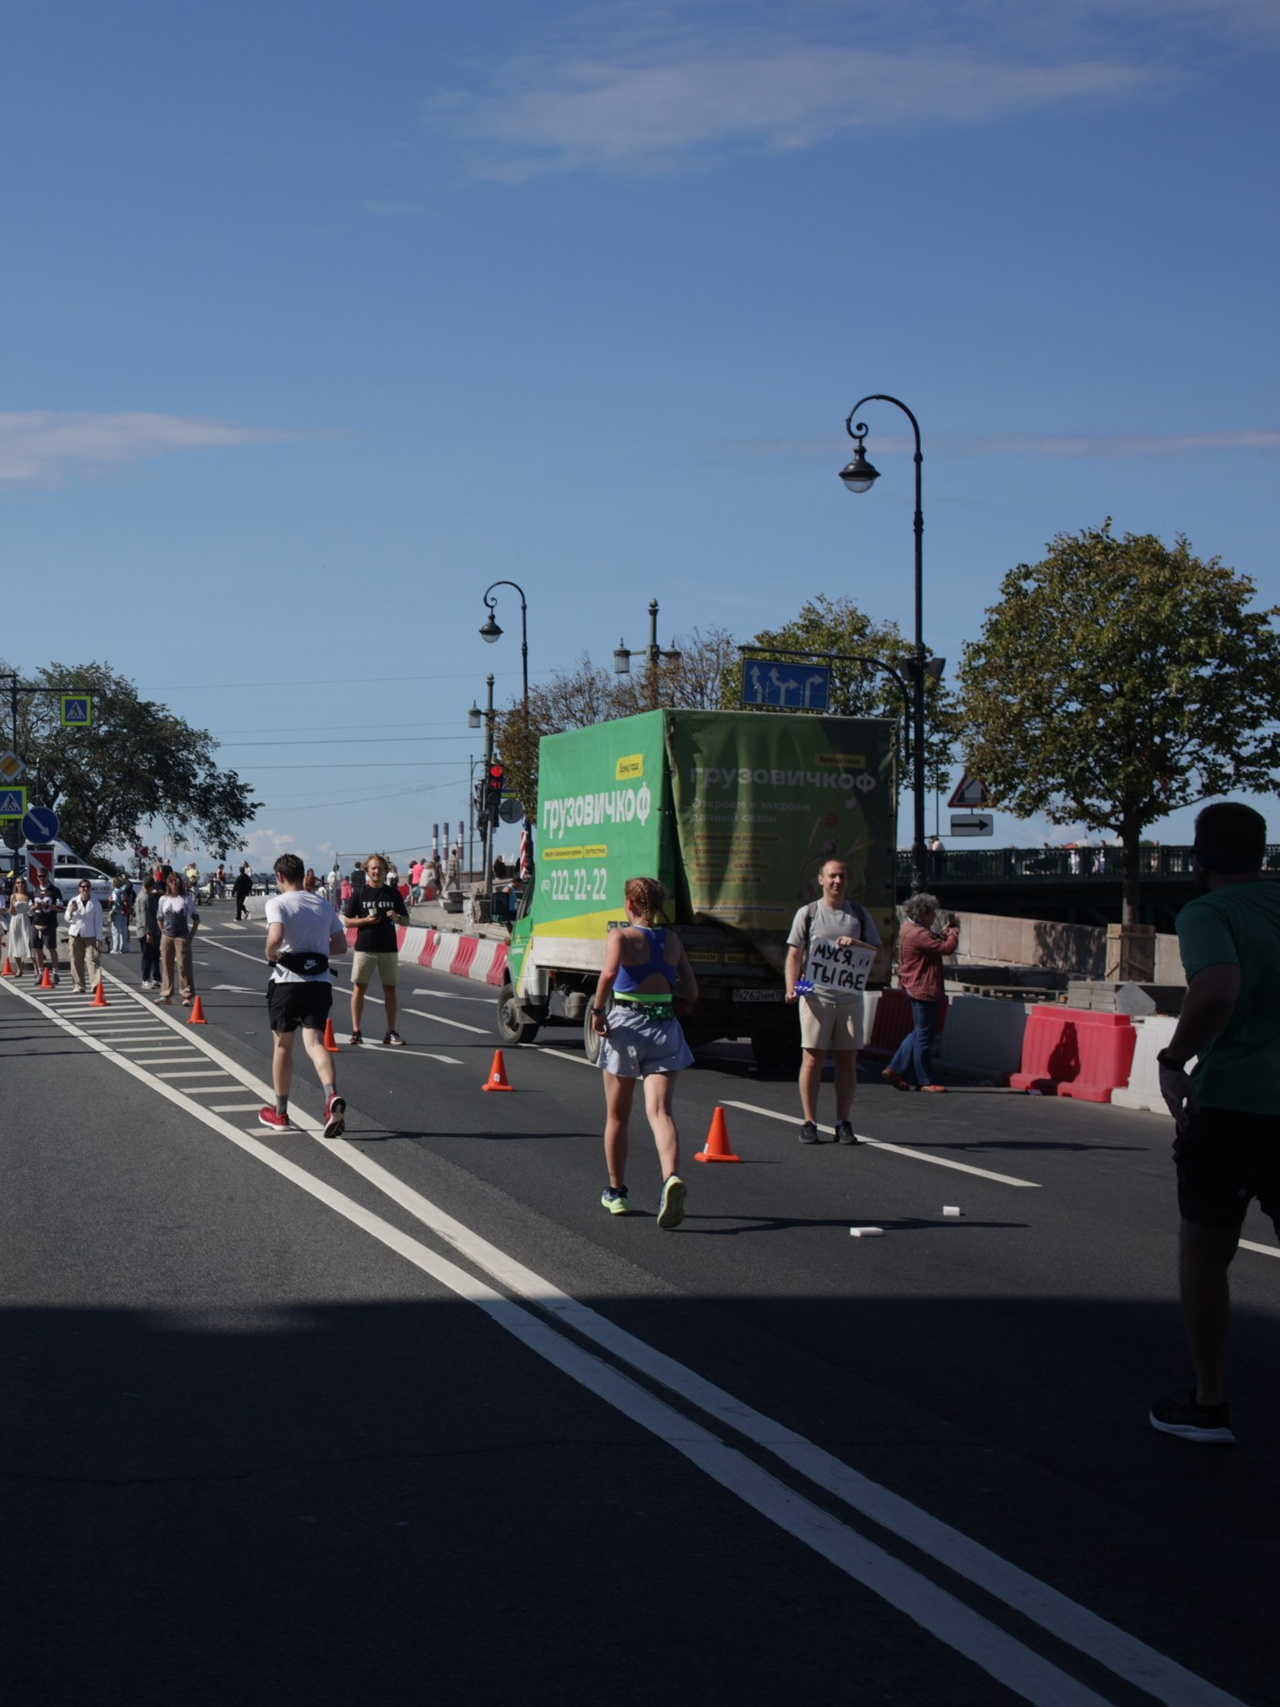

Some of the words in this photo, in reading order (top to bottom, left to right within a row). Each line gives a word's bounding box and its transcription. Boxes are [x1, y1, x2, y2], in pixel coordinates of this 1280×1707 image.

[690, 767, 876, 793] грузовичкоф
[543, 781, 651, 839] грузовичкоф
[759, 801, 810, 813] закроем
[551, 868, 607, 900] 222-22-22
[811, 962, 836, 984] ТЫ
[838, 970, 865, 991] ГДЕ
